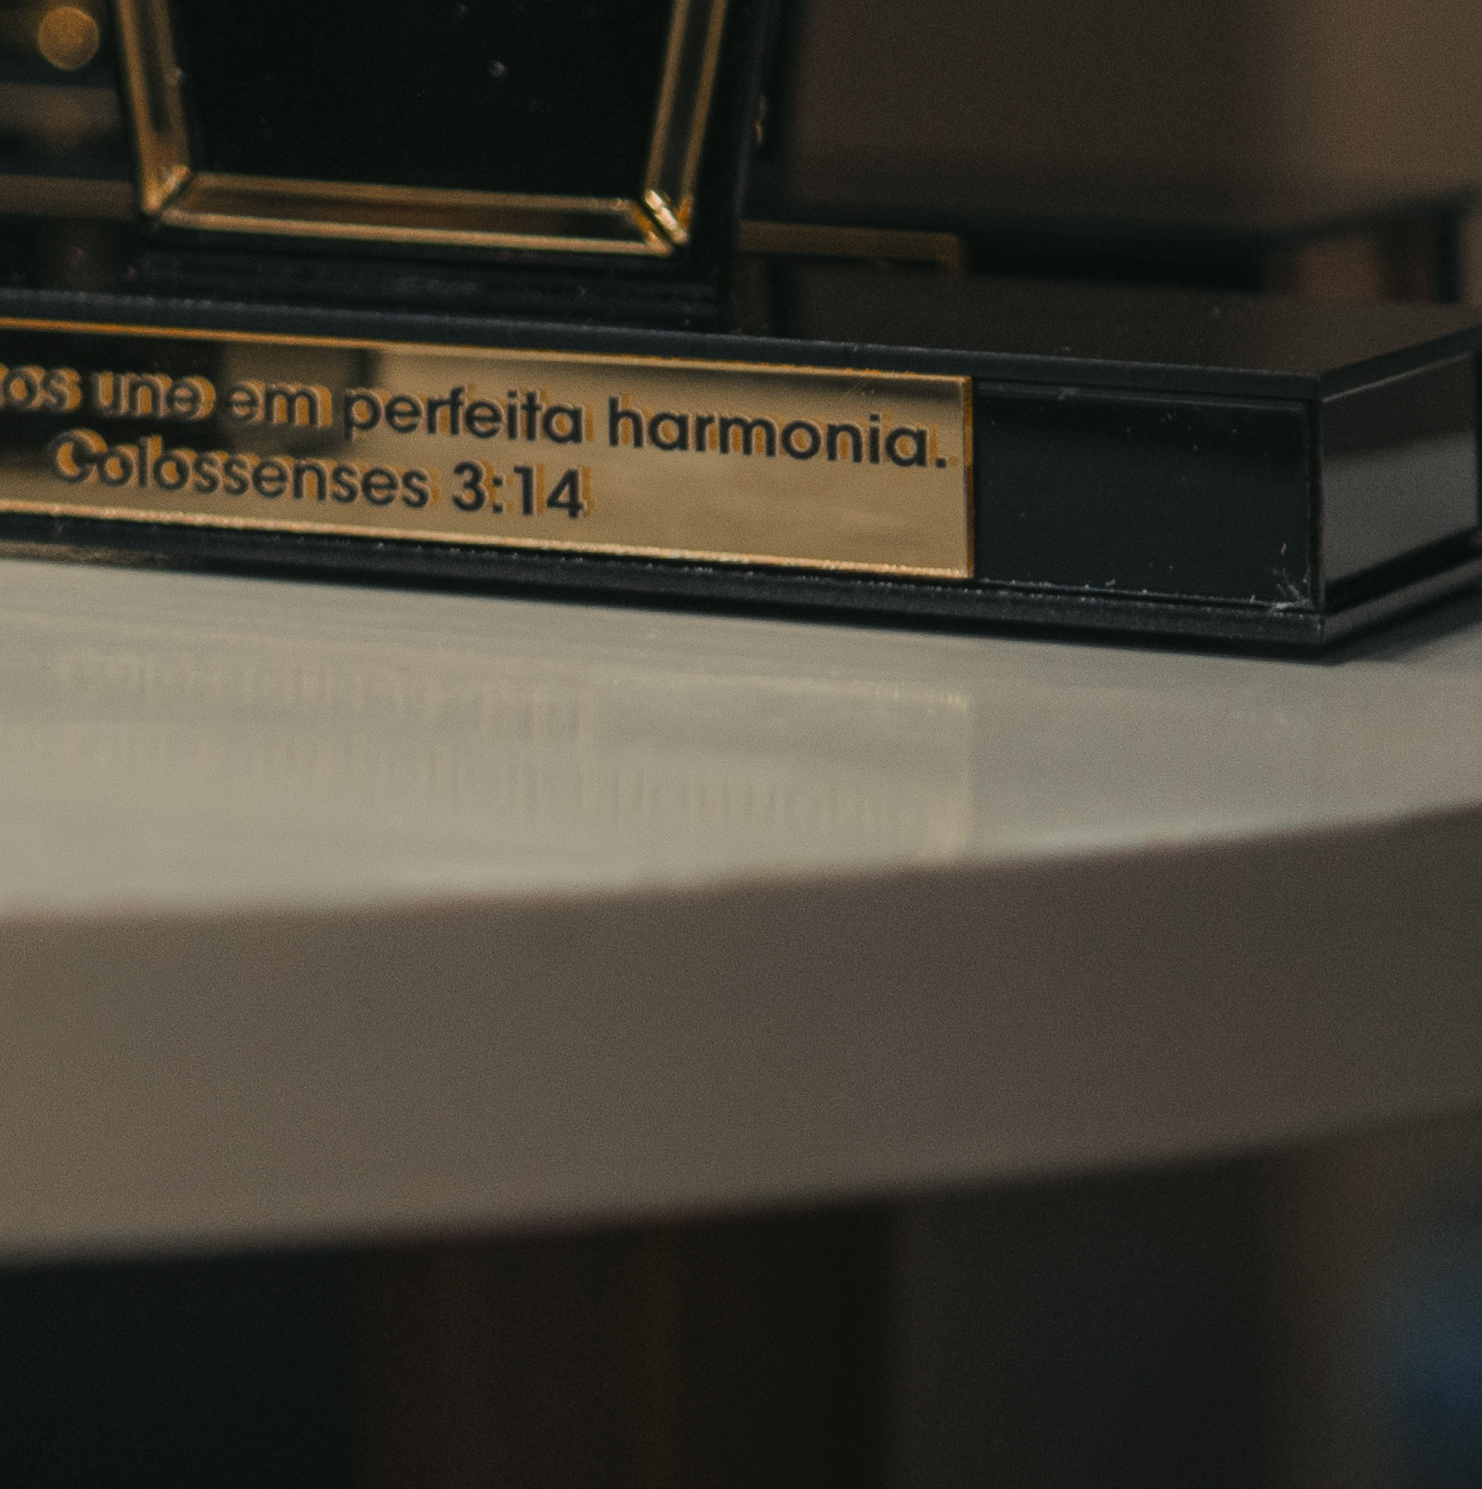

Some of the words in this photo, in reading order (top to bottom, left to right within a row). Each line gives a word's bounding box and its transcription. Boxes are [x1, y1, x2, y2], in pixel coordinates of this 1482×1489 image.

[93, 372, 215, 421] une
[227, 379, 332, 425] em
[344, 384, 585, 444] perfeita
[608, 395, 949, 469] harmonia.
[55, 428, 431, 510] Colossenses
[452, 460, 589, 519] 3:14
